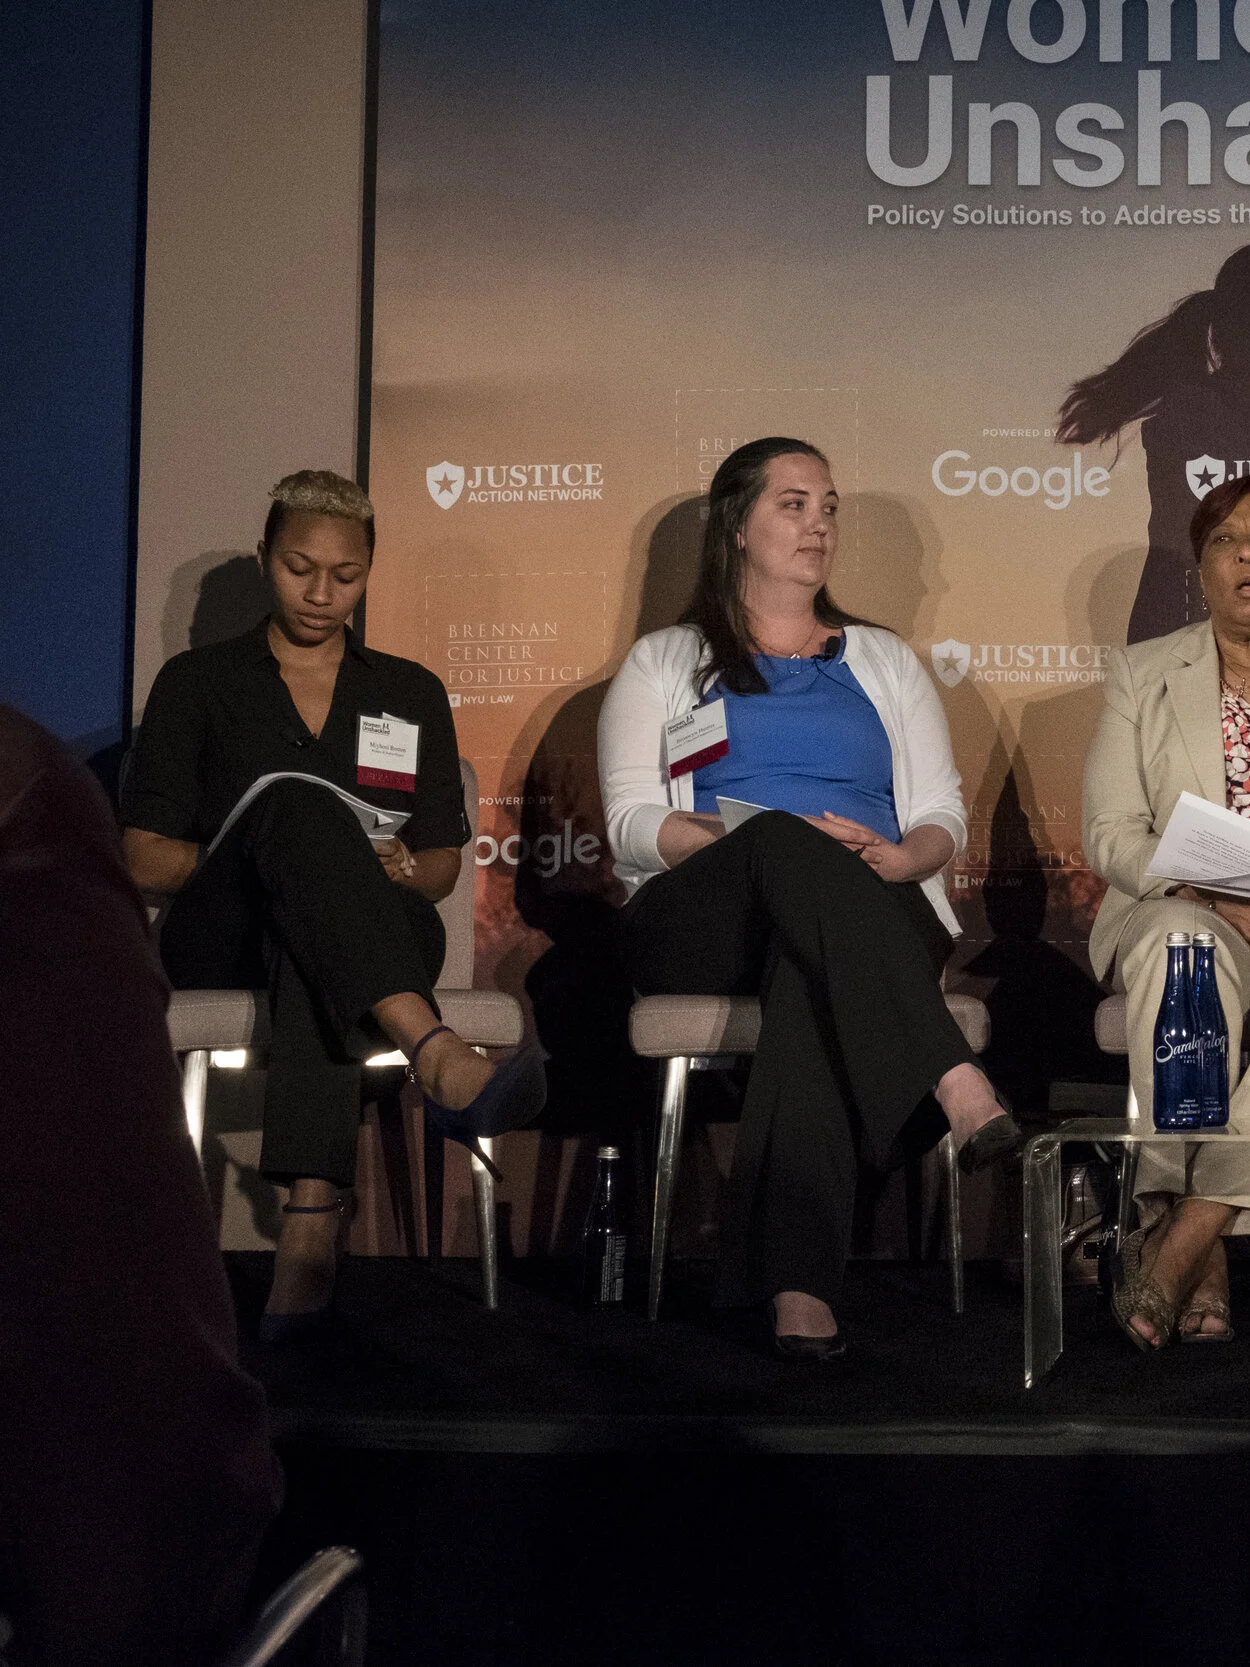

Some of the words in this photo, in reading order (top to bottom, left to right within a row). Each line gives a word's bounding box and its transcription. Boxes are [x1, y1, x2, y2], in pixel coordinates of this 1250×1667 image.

[867, 203, 943, 229] Policy
[952, 203, 1073, 226] Solutions
[1080, 205, 1107, 226] to
[1114, 203, 1222, 226] Address
[982, 429, 1040, 438] POWERED
[1044, 428, 1058, 437] BY
[467, 463, 604, 489] JUSTICE
[931, 449, 1111, 510] Google
[467, 490, 524, 503] ACTION
[527, 488, 603, 502] NETWORK
[449, 622, 557, 639] BRENNAN
[448, 645, 534, 662] CENTER
[973, 644, 1111, 668] JUSTICE
[449, 669, 488, 684] FOR
[498, 666, 585, 686] JUSTICE
[974, 670, 1031, 683] ACTION
[463, 695, 485, 705] NYU
[490, 695, 514, 704] LAW
[970, 804, 1067, 819] RENNAN
[970, 827, 1042, 842] ENTER
[474, 818, 601, 878] oogle
